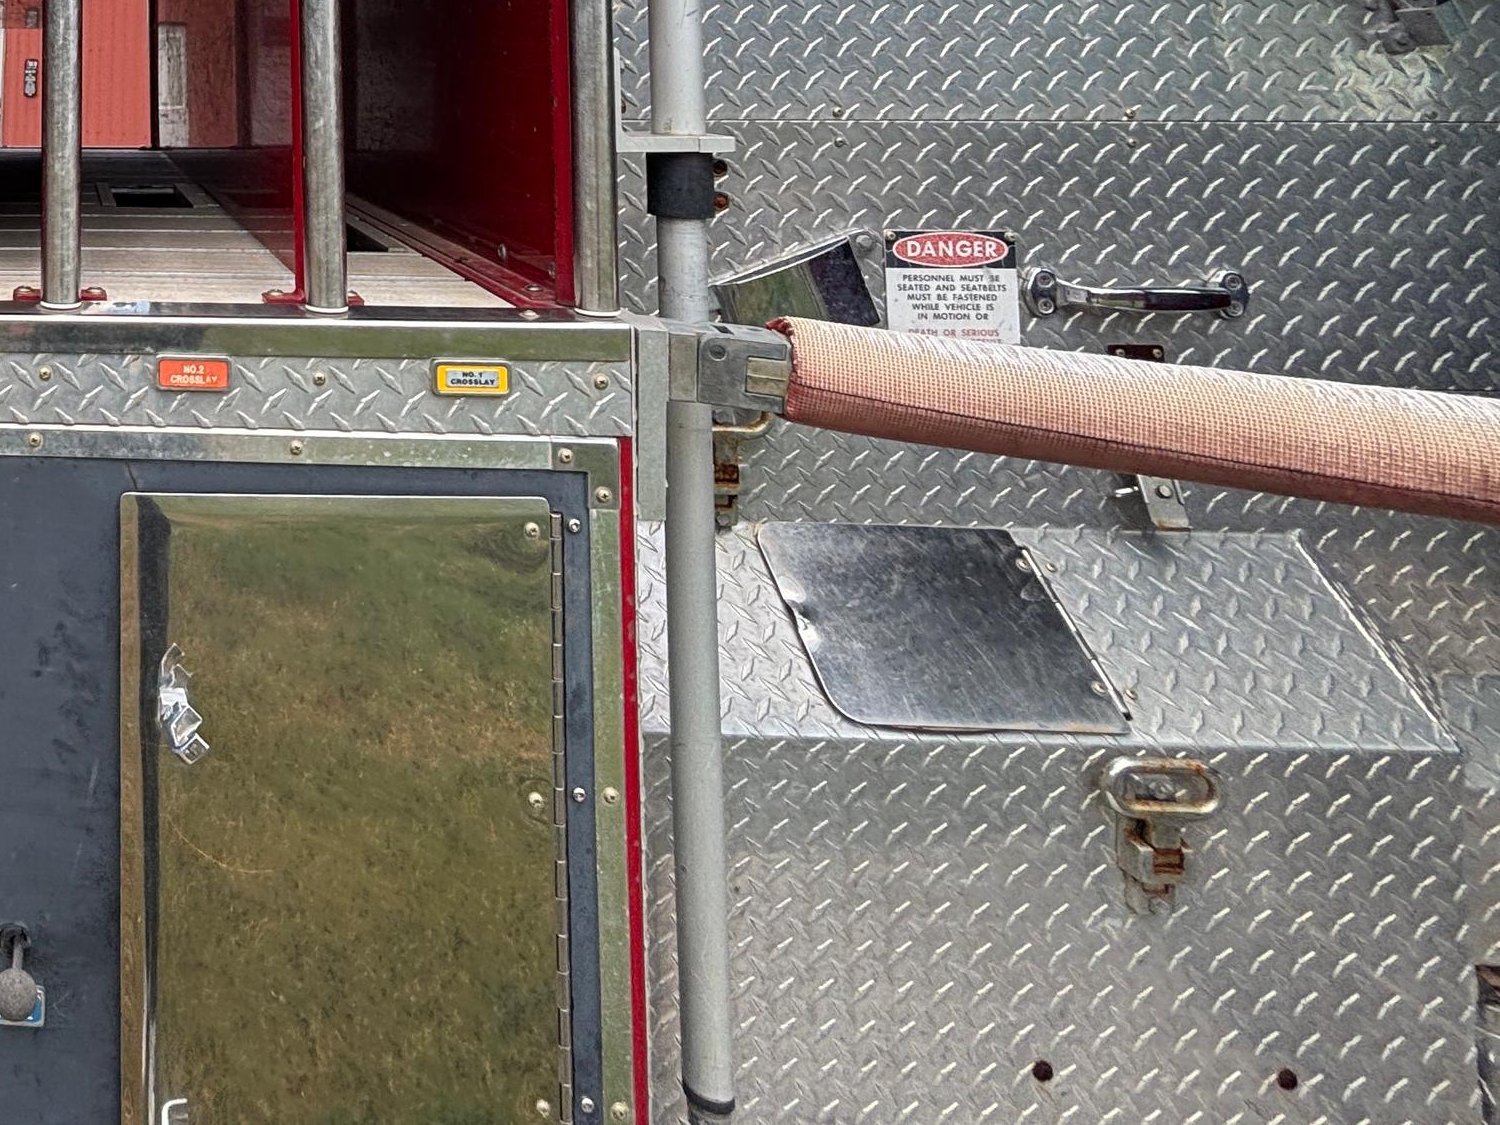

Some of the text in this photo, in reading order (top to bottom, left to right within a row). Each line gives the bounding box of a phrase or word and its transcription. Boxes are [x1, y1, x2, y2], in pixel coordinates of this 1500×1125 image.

[906, 240, 998, 257] DANGER
[902, 274, 1000, 282] PERSONNEL MUST BE
[907, 293, 998, 301] MUST BE FASTENED
[943, 328, 957, 336] OR
[961, 328, 1000, 336] SERIOUS
[170, 374, 218, 384] CROSSLAY
